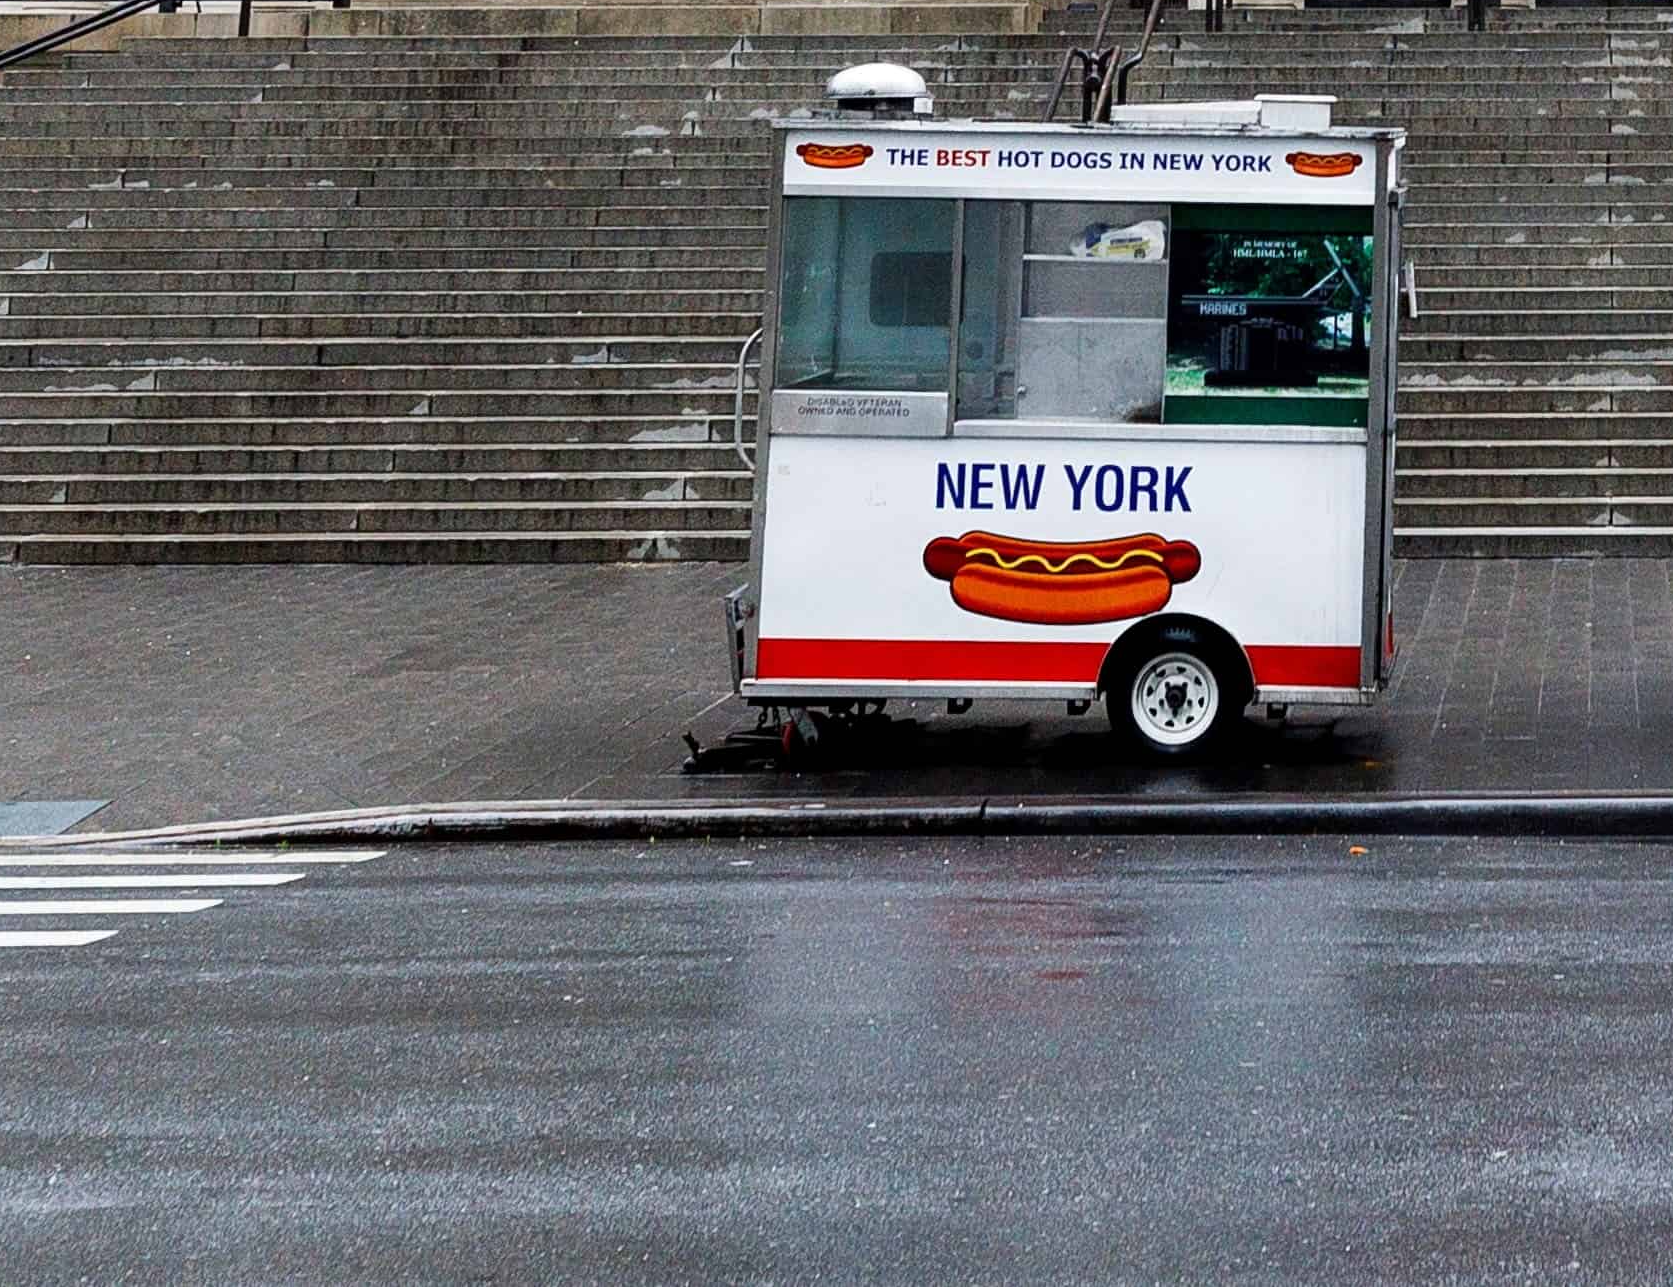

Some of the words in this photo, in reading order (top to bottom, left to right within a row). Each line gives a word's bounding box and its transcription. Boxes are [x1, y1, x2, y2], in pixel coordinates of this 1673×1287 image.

[886, 148, 929, 166] THE
[936, 149, 991, 167] BEST
[997, 150, 1044, 168] HOT
[1050, 151, 1113, 170] DOGS
[1119, 152, 1145, 170] IN
[1153, 153, 1204, 171] NEW
[1211, 154, 1272, 173] YORK
[1200, 303, 1246, 315] MARINES
[935, 462, 1046, 510] NEW
[1065, 464, 1193, 513] YORK
